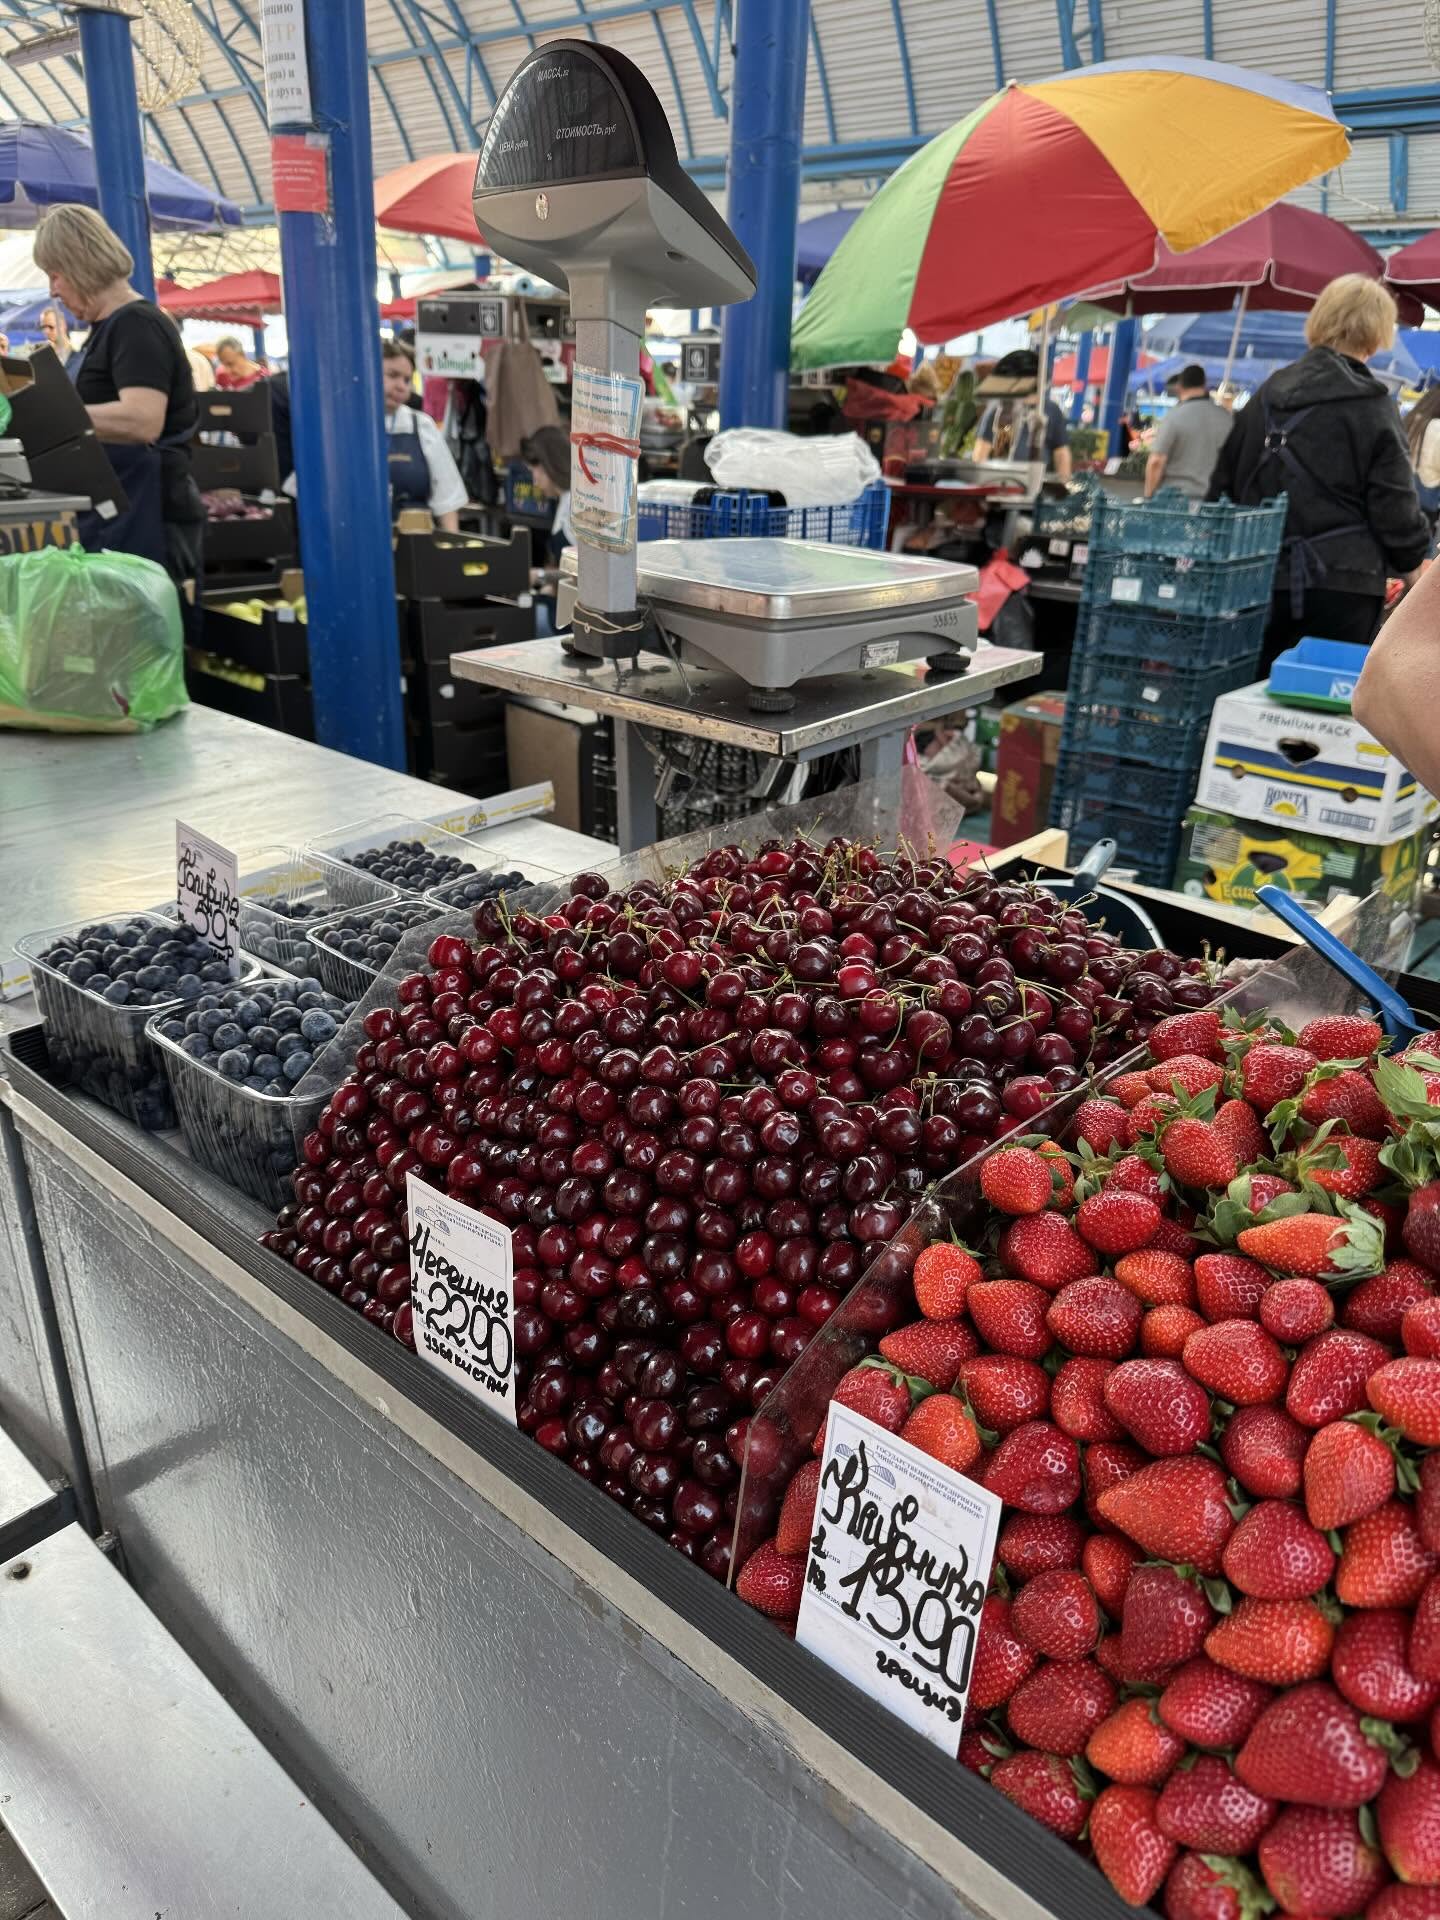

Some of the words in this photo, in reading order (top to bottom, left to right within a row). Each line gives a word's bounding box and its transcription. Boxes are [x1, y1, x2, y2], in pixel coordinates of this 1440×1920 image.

[1258, 712, 1315, 731] PREMIUM
[1318, 723, 1353, 737] PACK
[1264, 787, 1309, 817] BONITA
[425, 1281, 513, 1379] 22.90
